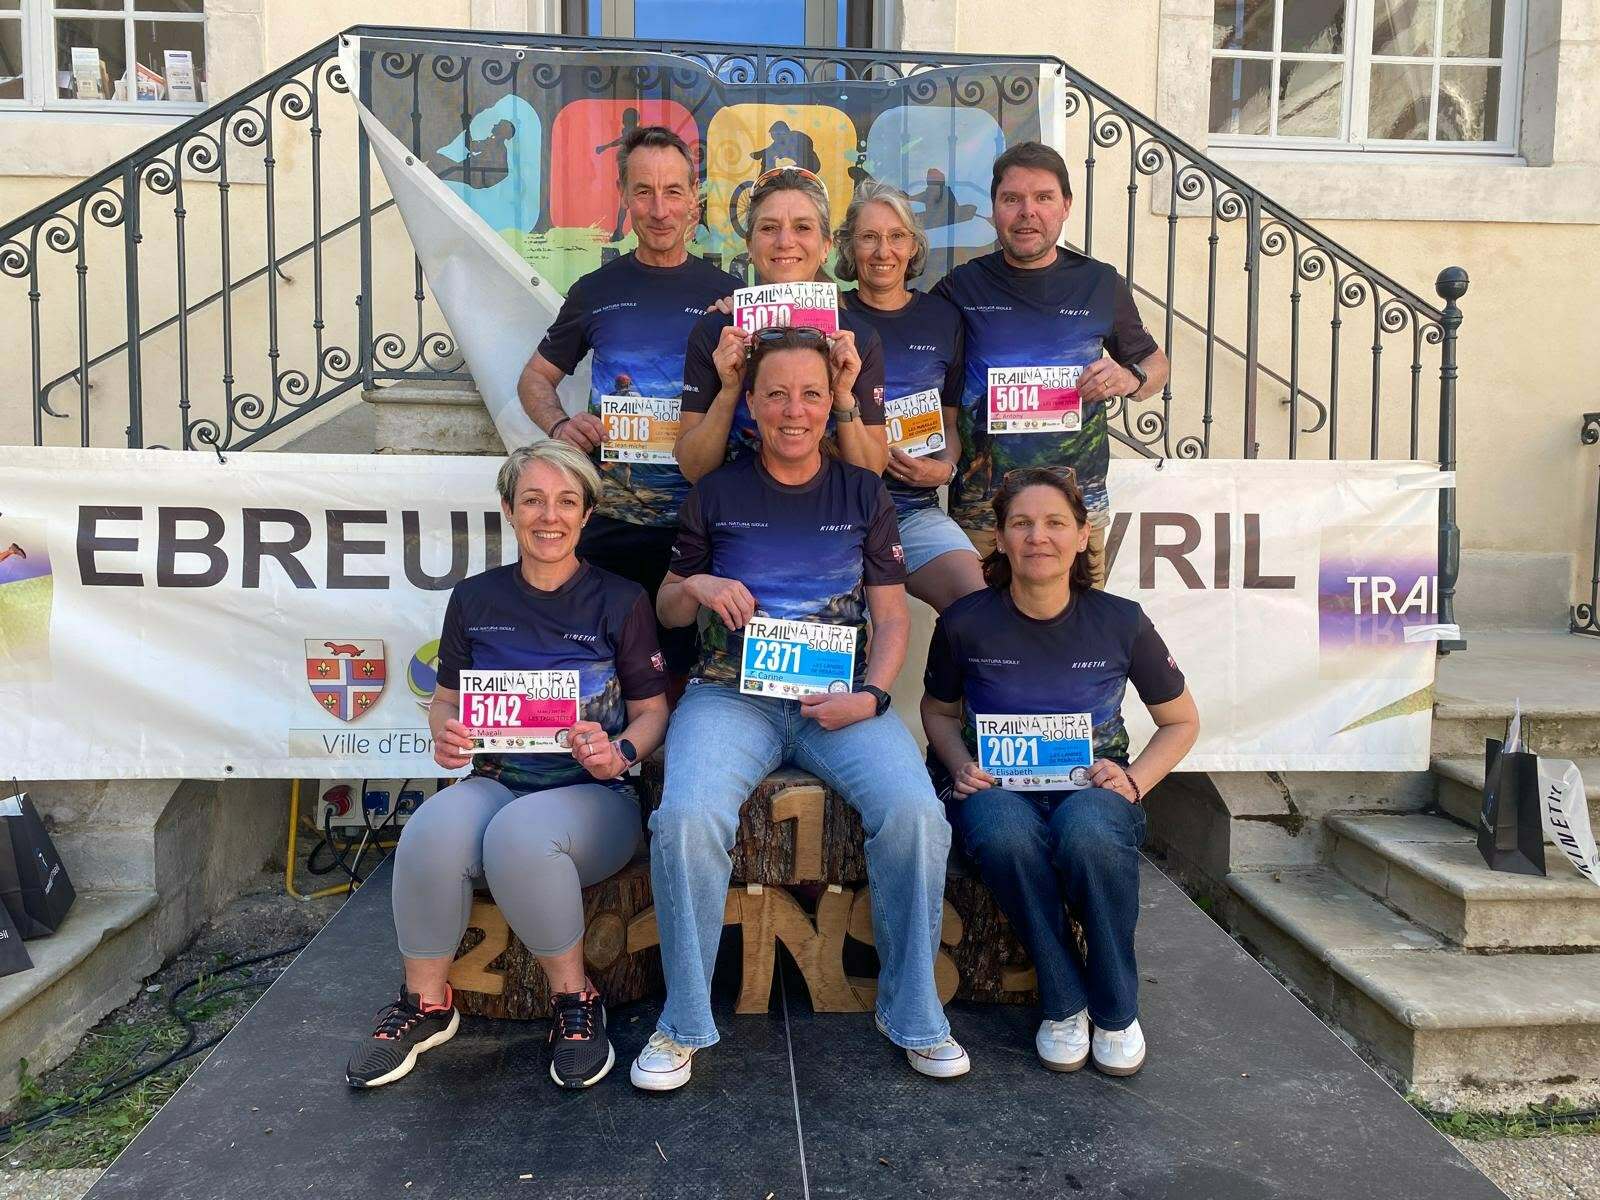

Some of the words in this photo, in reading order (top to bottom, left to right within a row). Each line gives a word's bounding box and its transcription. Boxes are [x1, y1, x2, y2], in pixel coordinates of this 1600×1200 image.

[793, 296, 835, 309] SIOULE
[908, 344, 937, 352] KINETIK
[996, 386, 1040, 412] 5014
[903, 401, 940, 419] SIOULE
[608, 415, 650, 441] 3018
[819, 524, 852, 532] KINETIK
[563, 633, 597, 642] KINETIK
[808, 638, 853, 653] SIOULE
[753, 640, 801, 673] 2371
[1071, 660, 1106, 669] KINETIK
[758, 671, 784, 681] Carine
[526, 687, 577, 700] SIOULE
[470, 694, 522, 727] 5142
[477, 729, 502, 737] Magali
[1042, 728, 1089, 741] SIOULE
[322, 733, 370, 754] Ville
[988, 737, 1038, 767] 2021
[996, 768, 1033, 776] Elisabeth
[771, 786, 826, 881] 1
